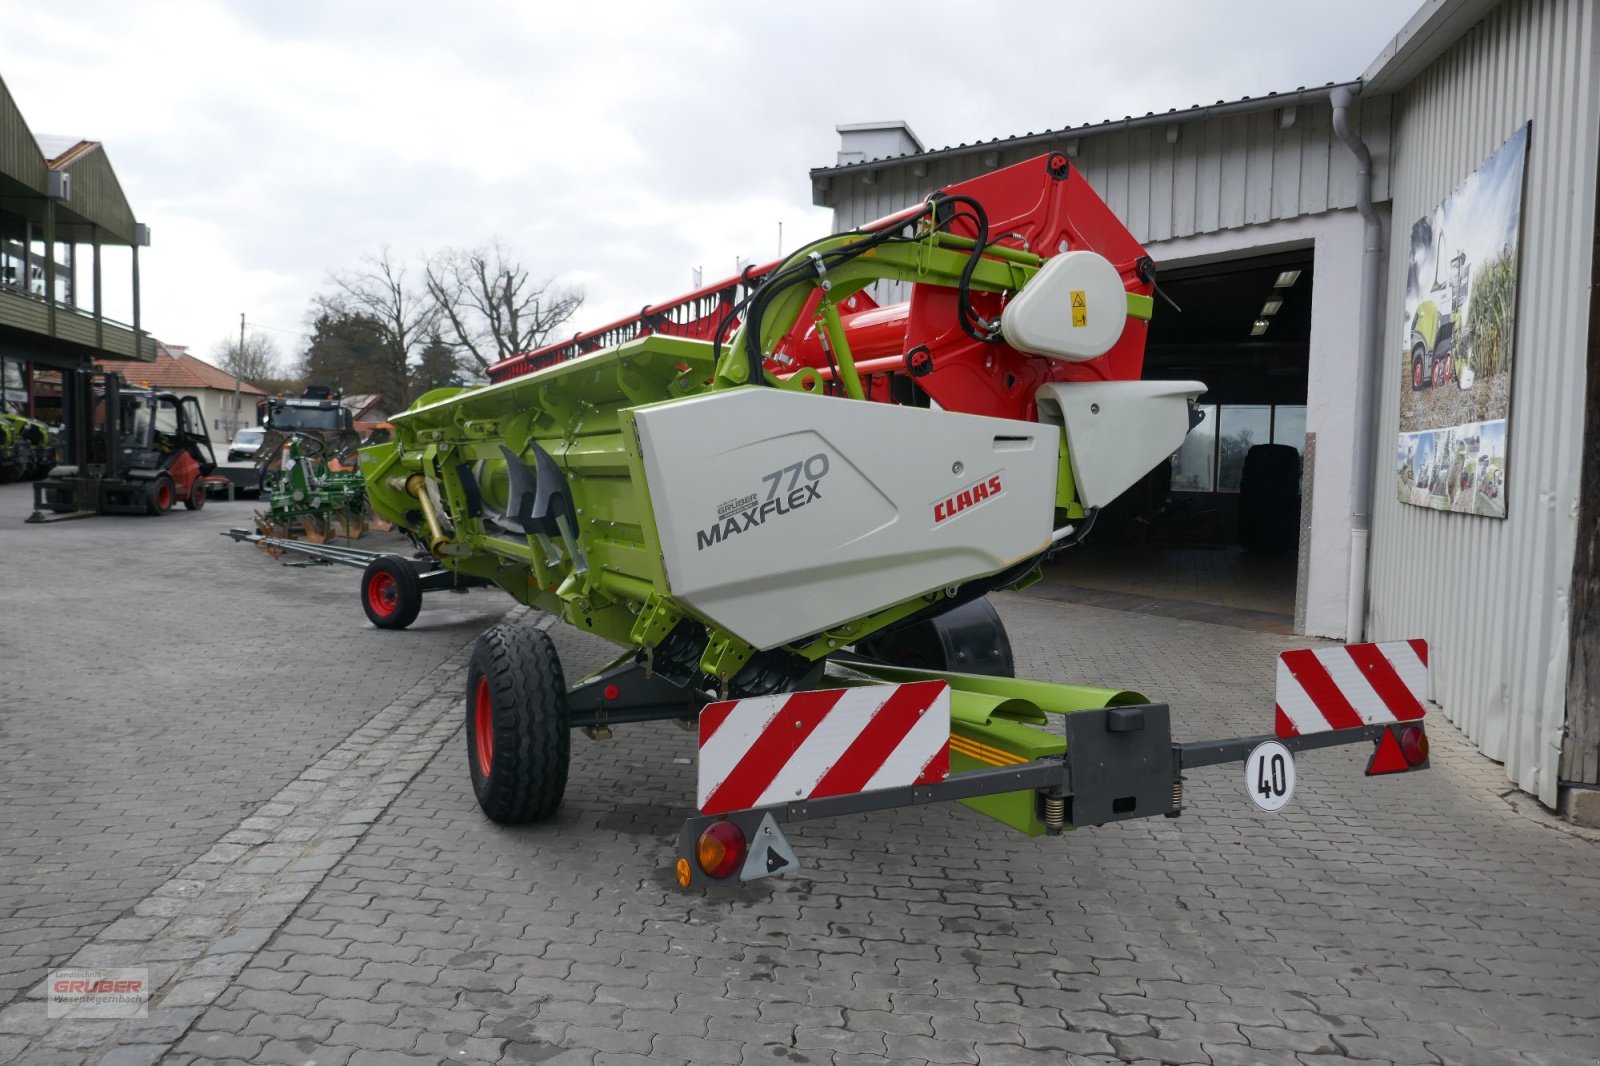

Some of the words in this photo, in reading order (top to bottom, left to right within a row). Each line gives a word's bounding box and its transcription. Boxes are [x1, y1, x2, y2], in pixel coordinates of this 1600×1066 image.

[761, 453, 830, 501] 770
[934, 475, 1002, 523] CLAAS
[696, 480, 822, 551] MAXFLEX
[717, 493, 758, 515] GRUBER
[1258, 753, 1286, 799] 40
